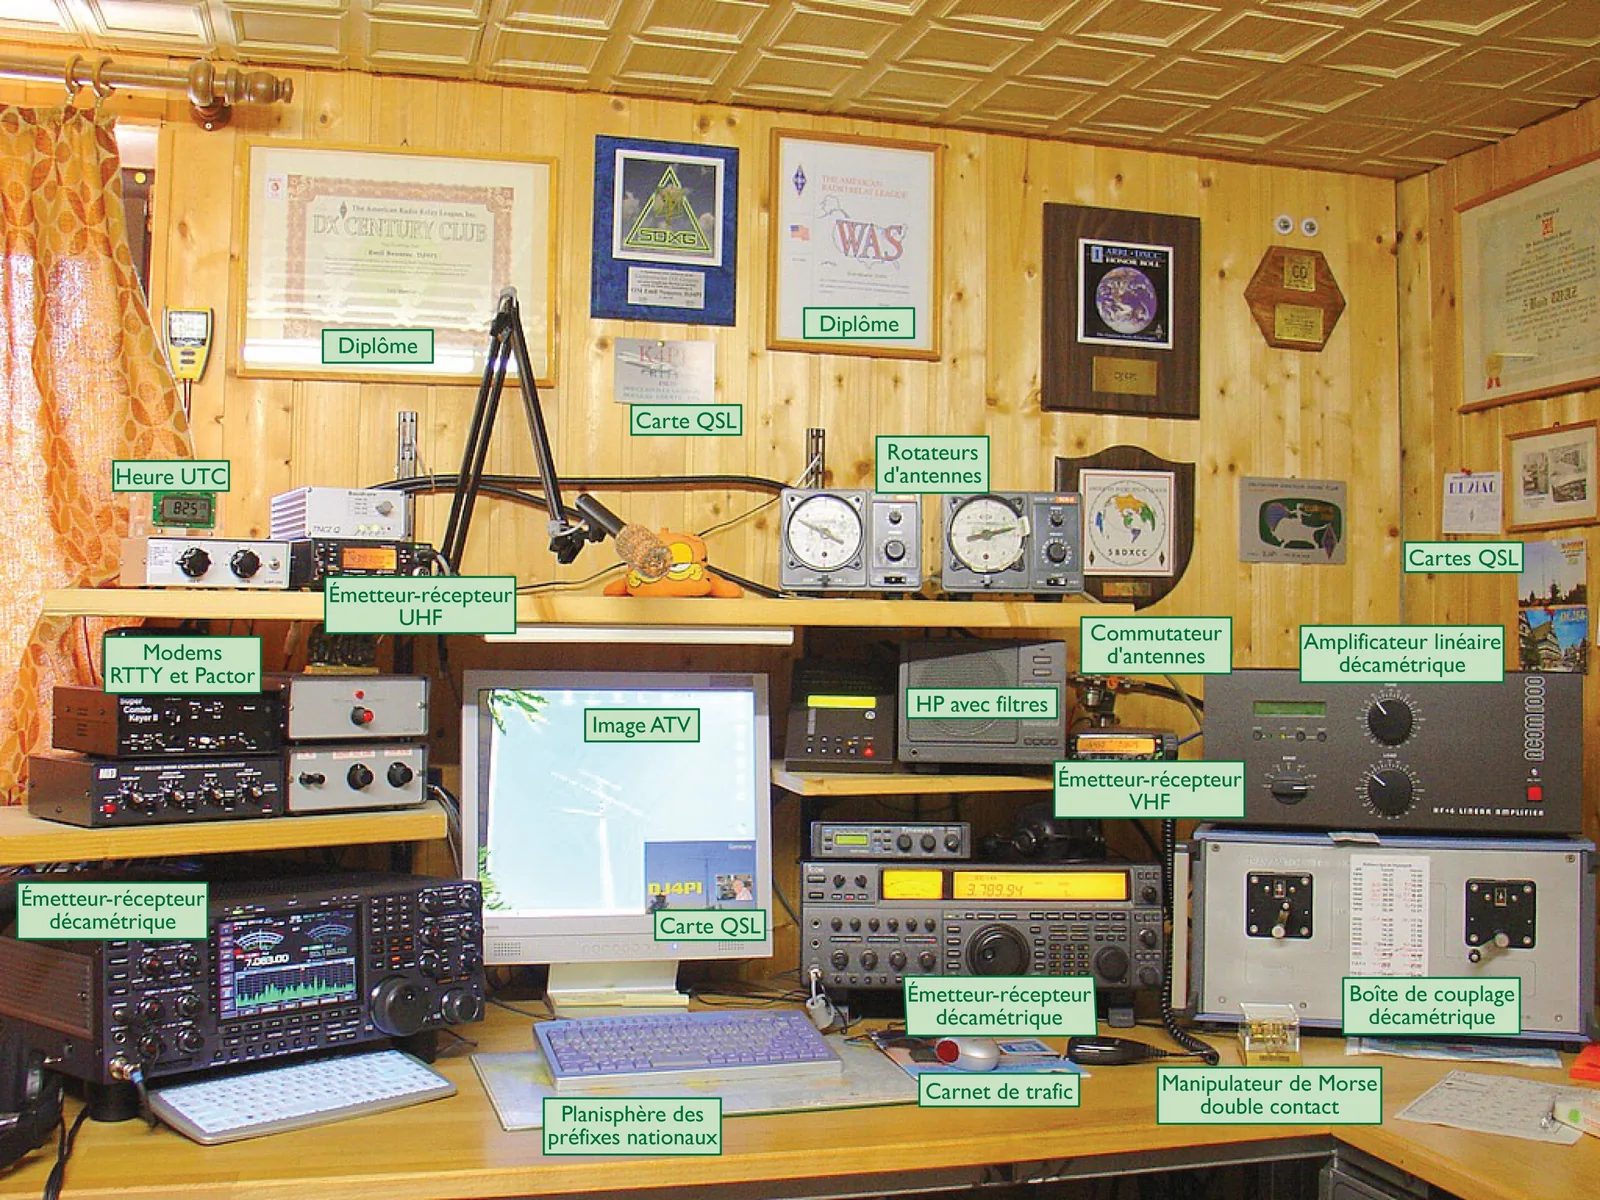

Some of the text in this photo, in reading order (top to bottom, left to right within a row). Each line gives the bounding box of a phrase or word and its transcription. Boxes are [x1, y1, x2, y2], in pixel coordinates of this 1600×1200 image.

[313, 214, 488, 243] DX CENTURY CLUB
[836, 220, 903, 262] WAS
[648, 881, 703, 895] DJ4PI
